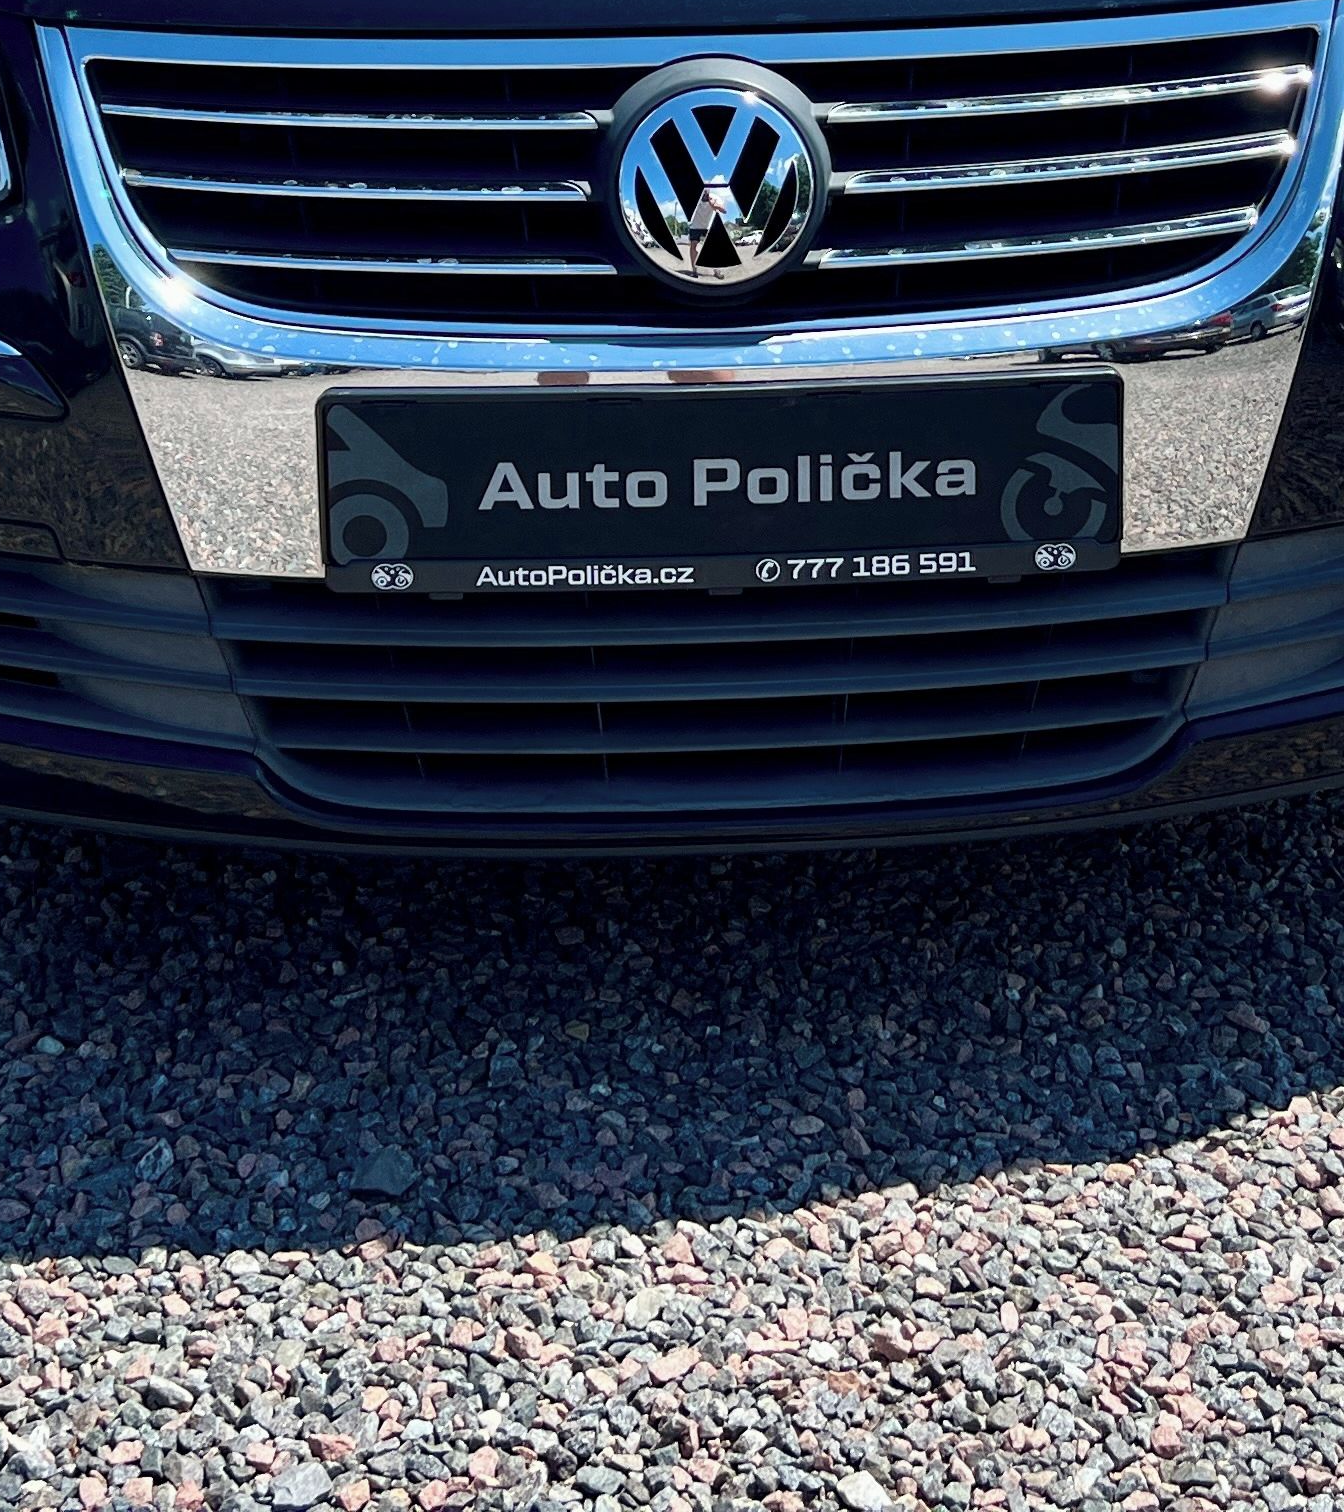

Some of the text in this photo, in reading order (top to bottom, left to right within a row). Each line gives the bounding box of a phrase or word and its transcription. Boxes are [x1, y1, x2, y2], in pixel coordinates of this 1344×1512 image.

[478, 451, 976, 510] Auto Polička
[475, 551, 977, 587] AutoPolička.cz 777 186 591
